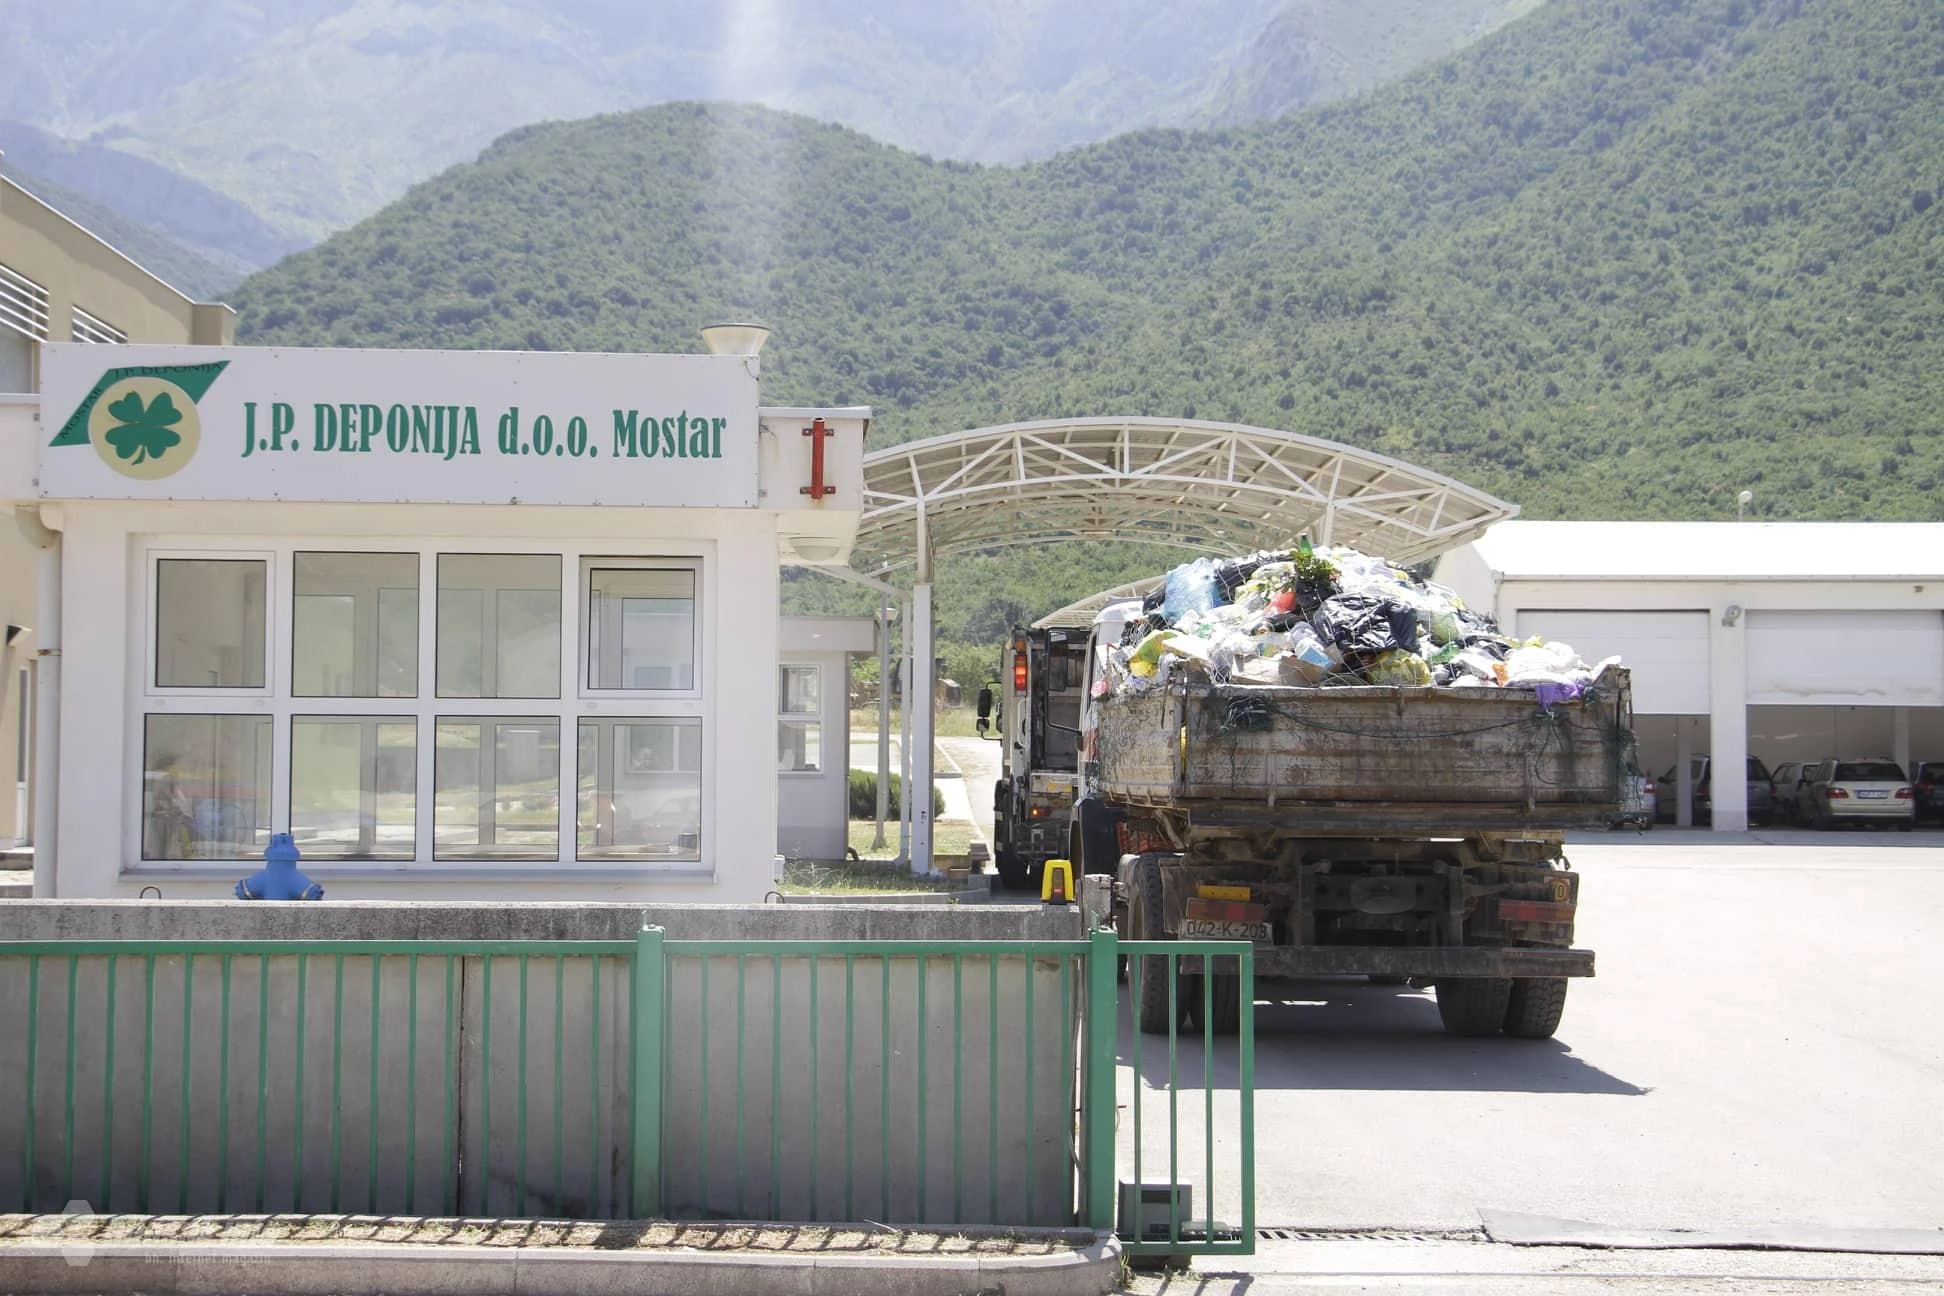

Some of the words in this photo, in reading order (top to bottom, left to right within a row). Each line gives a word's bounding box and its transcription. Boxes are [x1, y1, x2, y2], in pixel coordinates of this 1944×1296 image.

[141, 362, 222, 376] DEPONIJA
[60, 387, 102, 439] MOSTAR
[241, 402, 299, 458] J.P.
[313, 403, 482, 461] DEPONIJA
[498, 406, 598, 457] d.o.o.
[612, 409, 727, 458] Mostar
